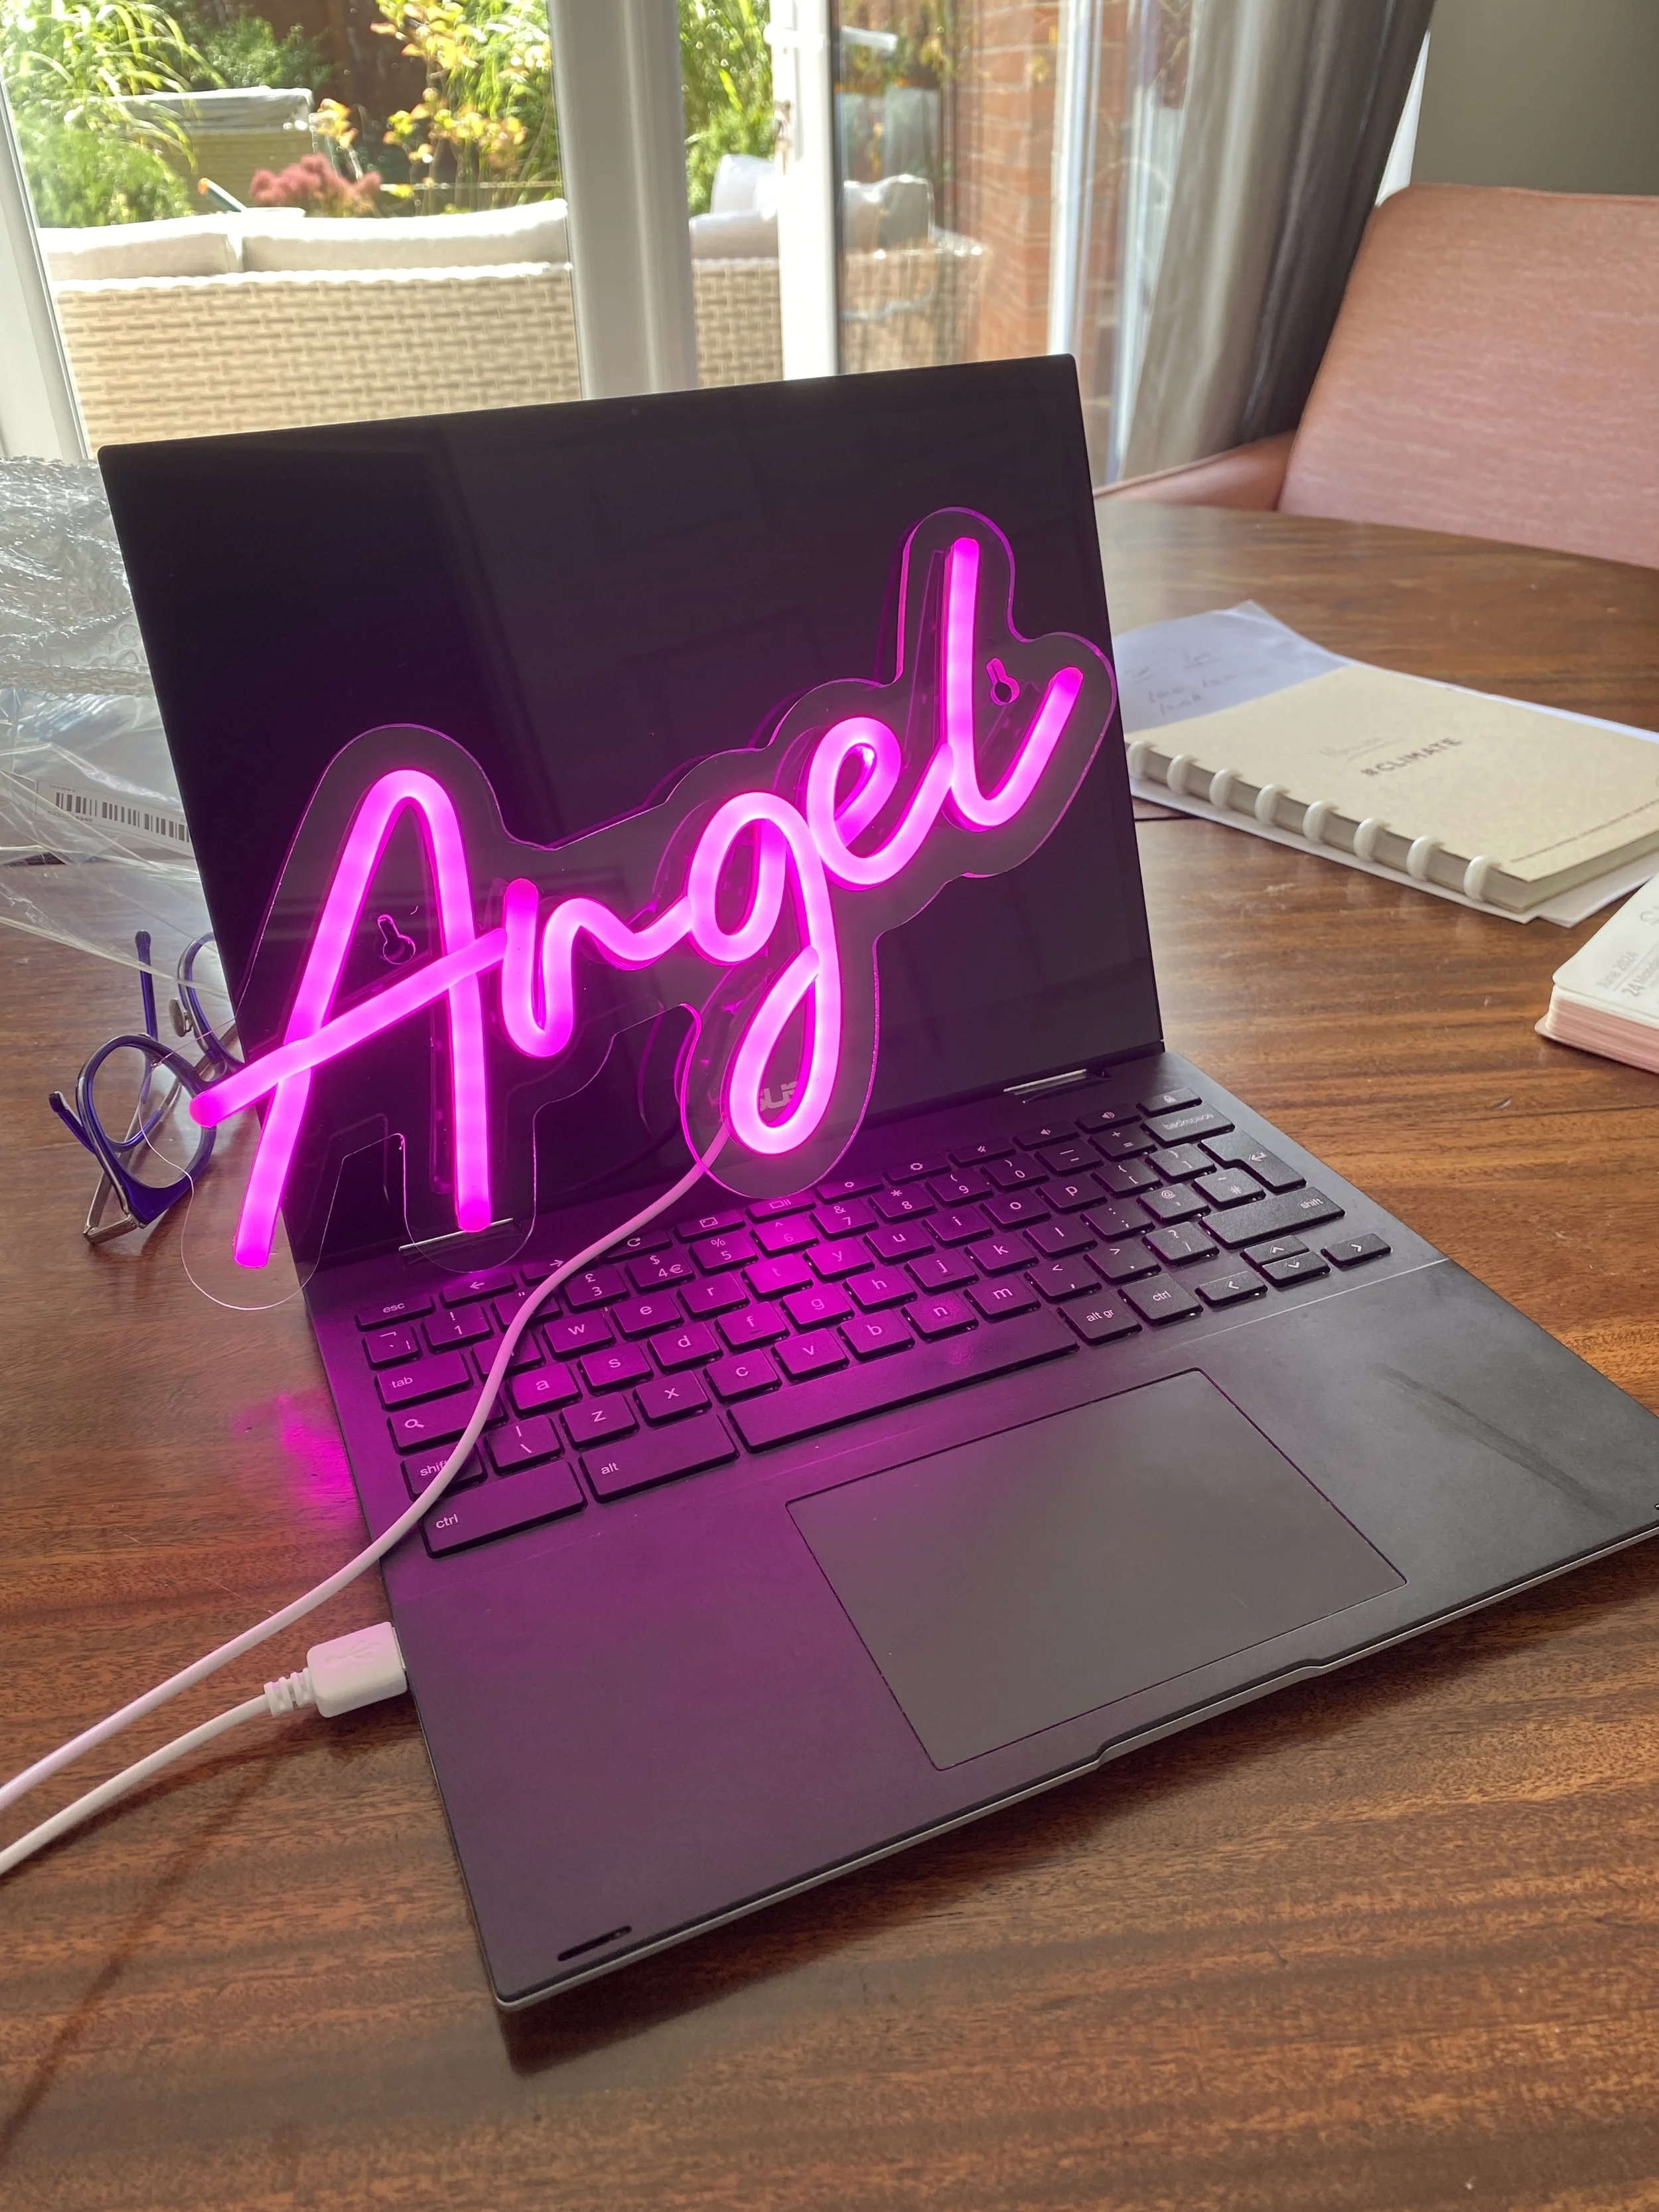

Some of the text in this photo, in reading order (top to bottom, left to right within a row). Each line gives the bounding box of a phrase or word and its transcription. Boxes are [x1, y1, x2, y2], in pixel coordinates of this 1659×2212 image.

[190, 536, 1084, 1268] Angel
[958, 1185, 969, 1194] 9
[1065, 1186, 1078, 1197] p
[1161, 1190, 1176, 1199] @
[1230, 1185, 1242, 1195] #
[901, 1201, 913, 1210] 8
[1299, 1197, 1323, 1209] shift
[833, 1205, 846, 1214] &
[842, 1217, 851, 1226] 7
[952, 1216, 962, 1226] i
[783, 1233, 794, 1242] 6
[892, 1234, 906, 1242] u
[1168, 1230, 1179, 1238] ?
[711, 1238, 726, 1248] %
[993, 1245, 1009, 1254] k
[650, 1255, 660, 1265] $
[721, 1250, 731, 1260] 5
[832, 1250, 843, 1262] y
[772, 1267, 781, 1276] t
[936, 1260, 948, 1273] j
[585, 1274, 596, 1283] £
[871, 1280, 887, 1290] h
[592, 1286, 603, 1296] 3
[707, 1287, 714, 1296] r
[993, 1288, 1013, 1299] m
[1153, 1290, 1171, 1301] ctrl
[383, 1303, 405, 1313] esc
[811, 1298, 825, 1310] g
[640, 1305, 652, 1315] e
[933, 1306, 948, 1317] n
[746, 1315, 755, 1327] f
[1086, 1309, 1114, 1323] alt gr
[455, 1325, 463, 1335] 1
[568, 1324, 585, 1335] w
[867, 1325, 883, 1337] b
[678, 1335, 691, 1347] d
[392, 1376, 413, 1388] tab
[536, 1380, 549, 1390] a
[665, 1388, 680, 1399] x
[601, 1461, 618, 1475] alt
[435, 1514, 459, 1528] ctrl
